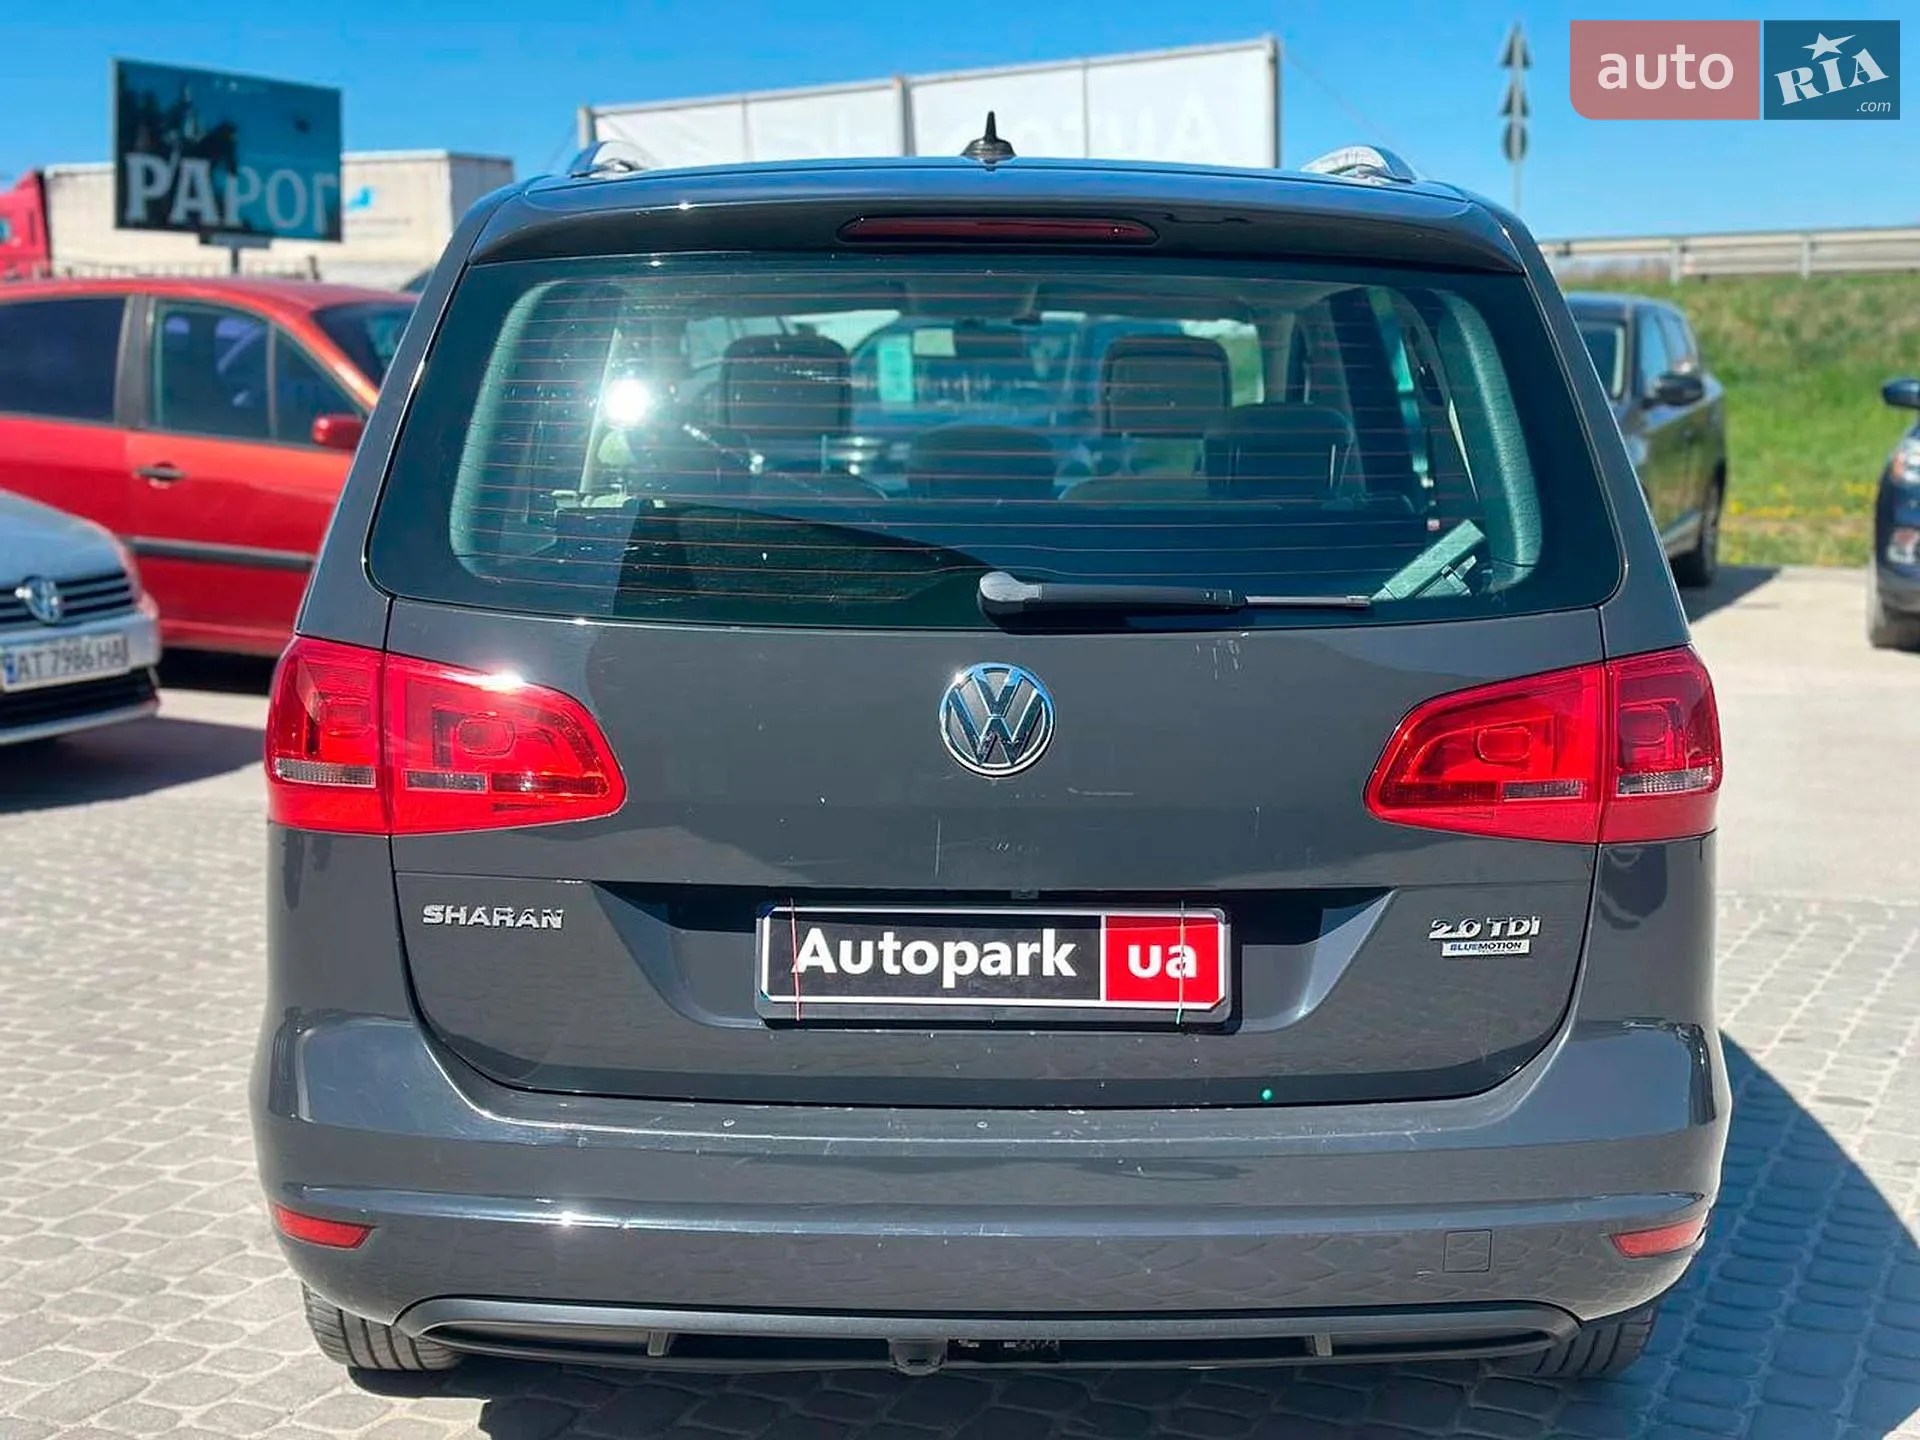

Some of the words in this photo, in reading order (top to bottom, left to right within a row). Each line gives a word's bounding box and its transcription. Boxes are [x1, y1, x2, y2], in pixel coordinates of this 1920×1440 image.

[423, 904, 564, 929] SHARAN
[1429, 918, 1481, 939] 2.0
[1486, 916, 1540, 937] TDI
[793, 928, 1077, 988] Autopark
[1128, 943, 1198, 979] ua
